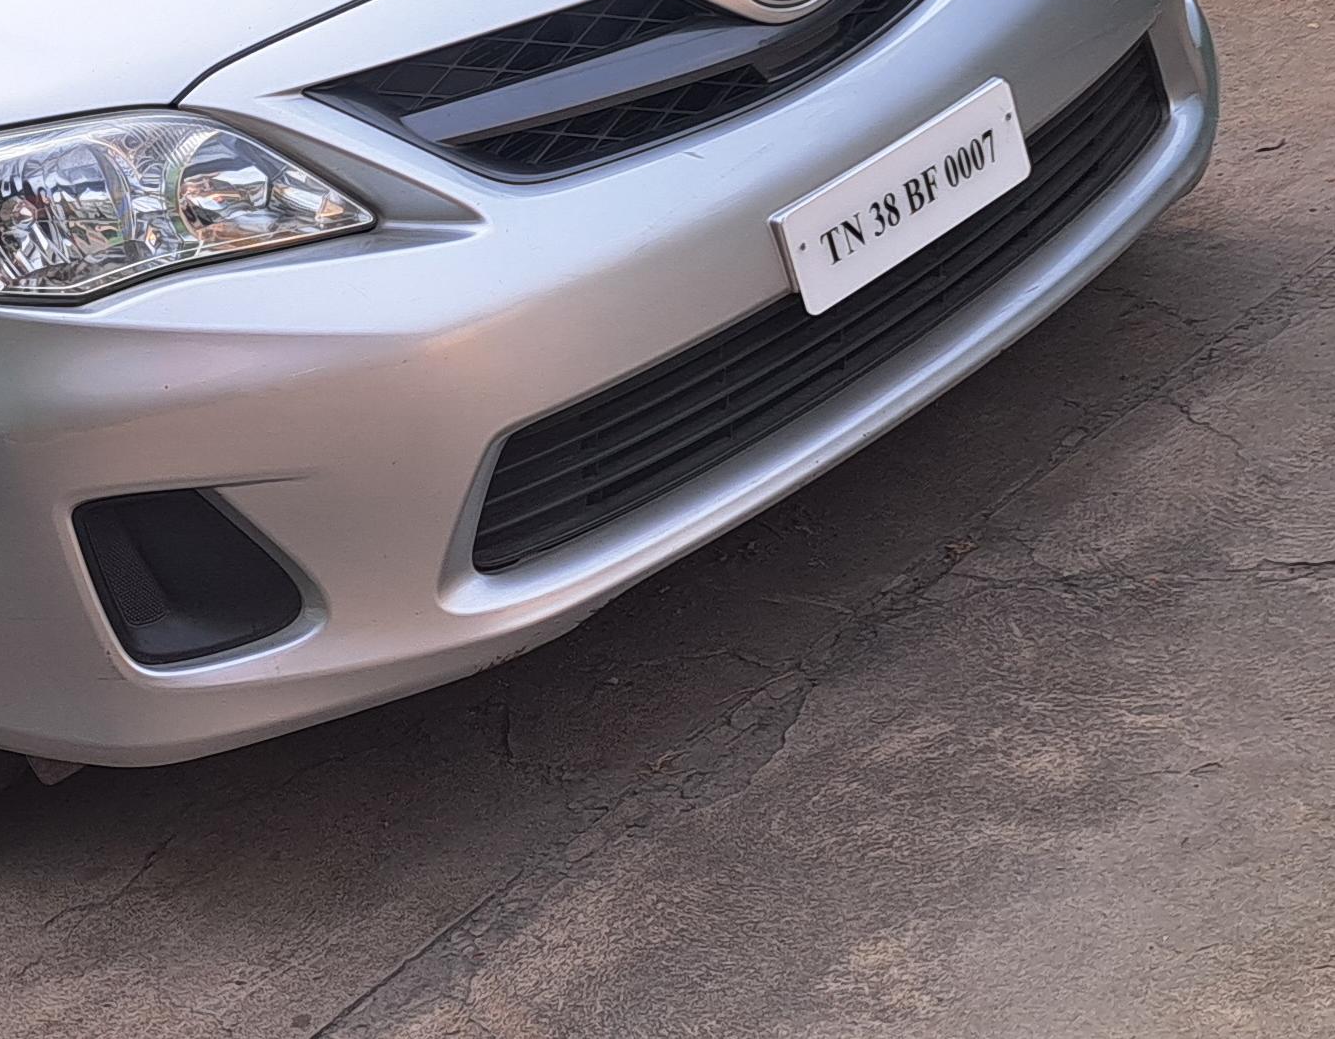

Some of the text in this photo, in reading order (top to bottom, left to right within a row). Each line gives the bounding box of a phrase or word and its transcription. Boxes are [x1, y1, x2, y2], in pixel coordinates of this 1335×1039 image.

[820, 129, 996, 265] TN 38 BF 0007
